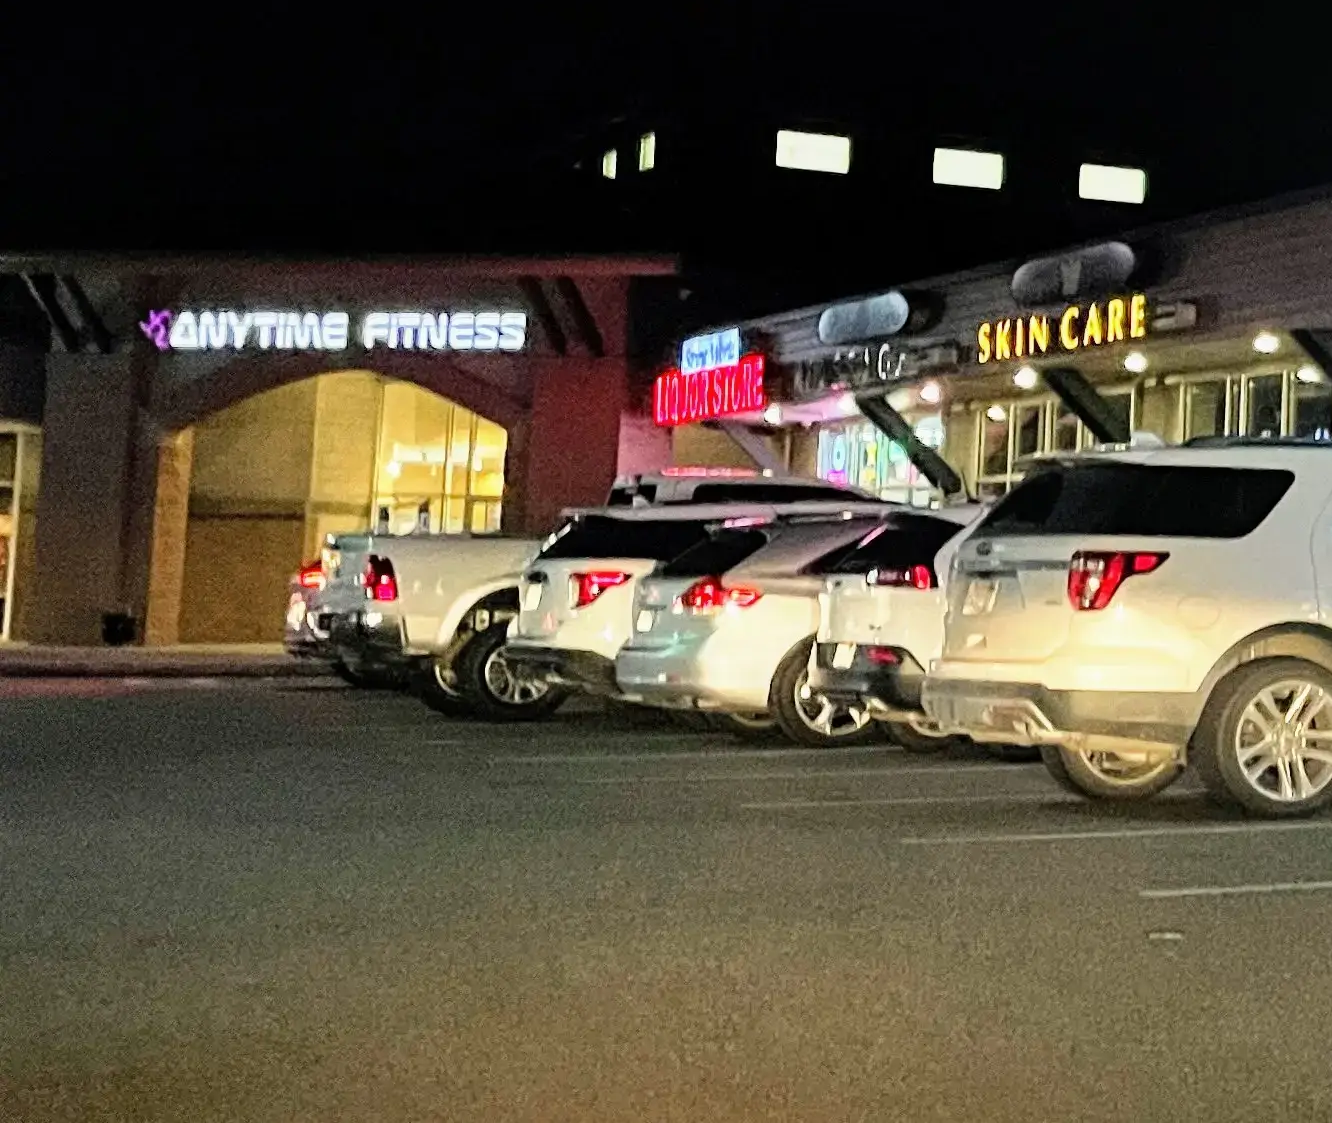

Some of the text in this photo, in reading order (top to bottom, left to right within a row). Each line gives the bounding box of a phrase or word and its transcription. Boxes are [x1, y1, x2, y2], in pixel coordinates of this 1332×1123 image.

[169, 311, 527, 351] ANYTIME FITNESS
[977, 293, 1146, 364] SKIN CARE
[656, 369, 709, 425] LIQUOR
[712, 354, 764, 414] STORE
